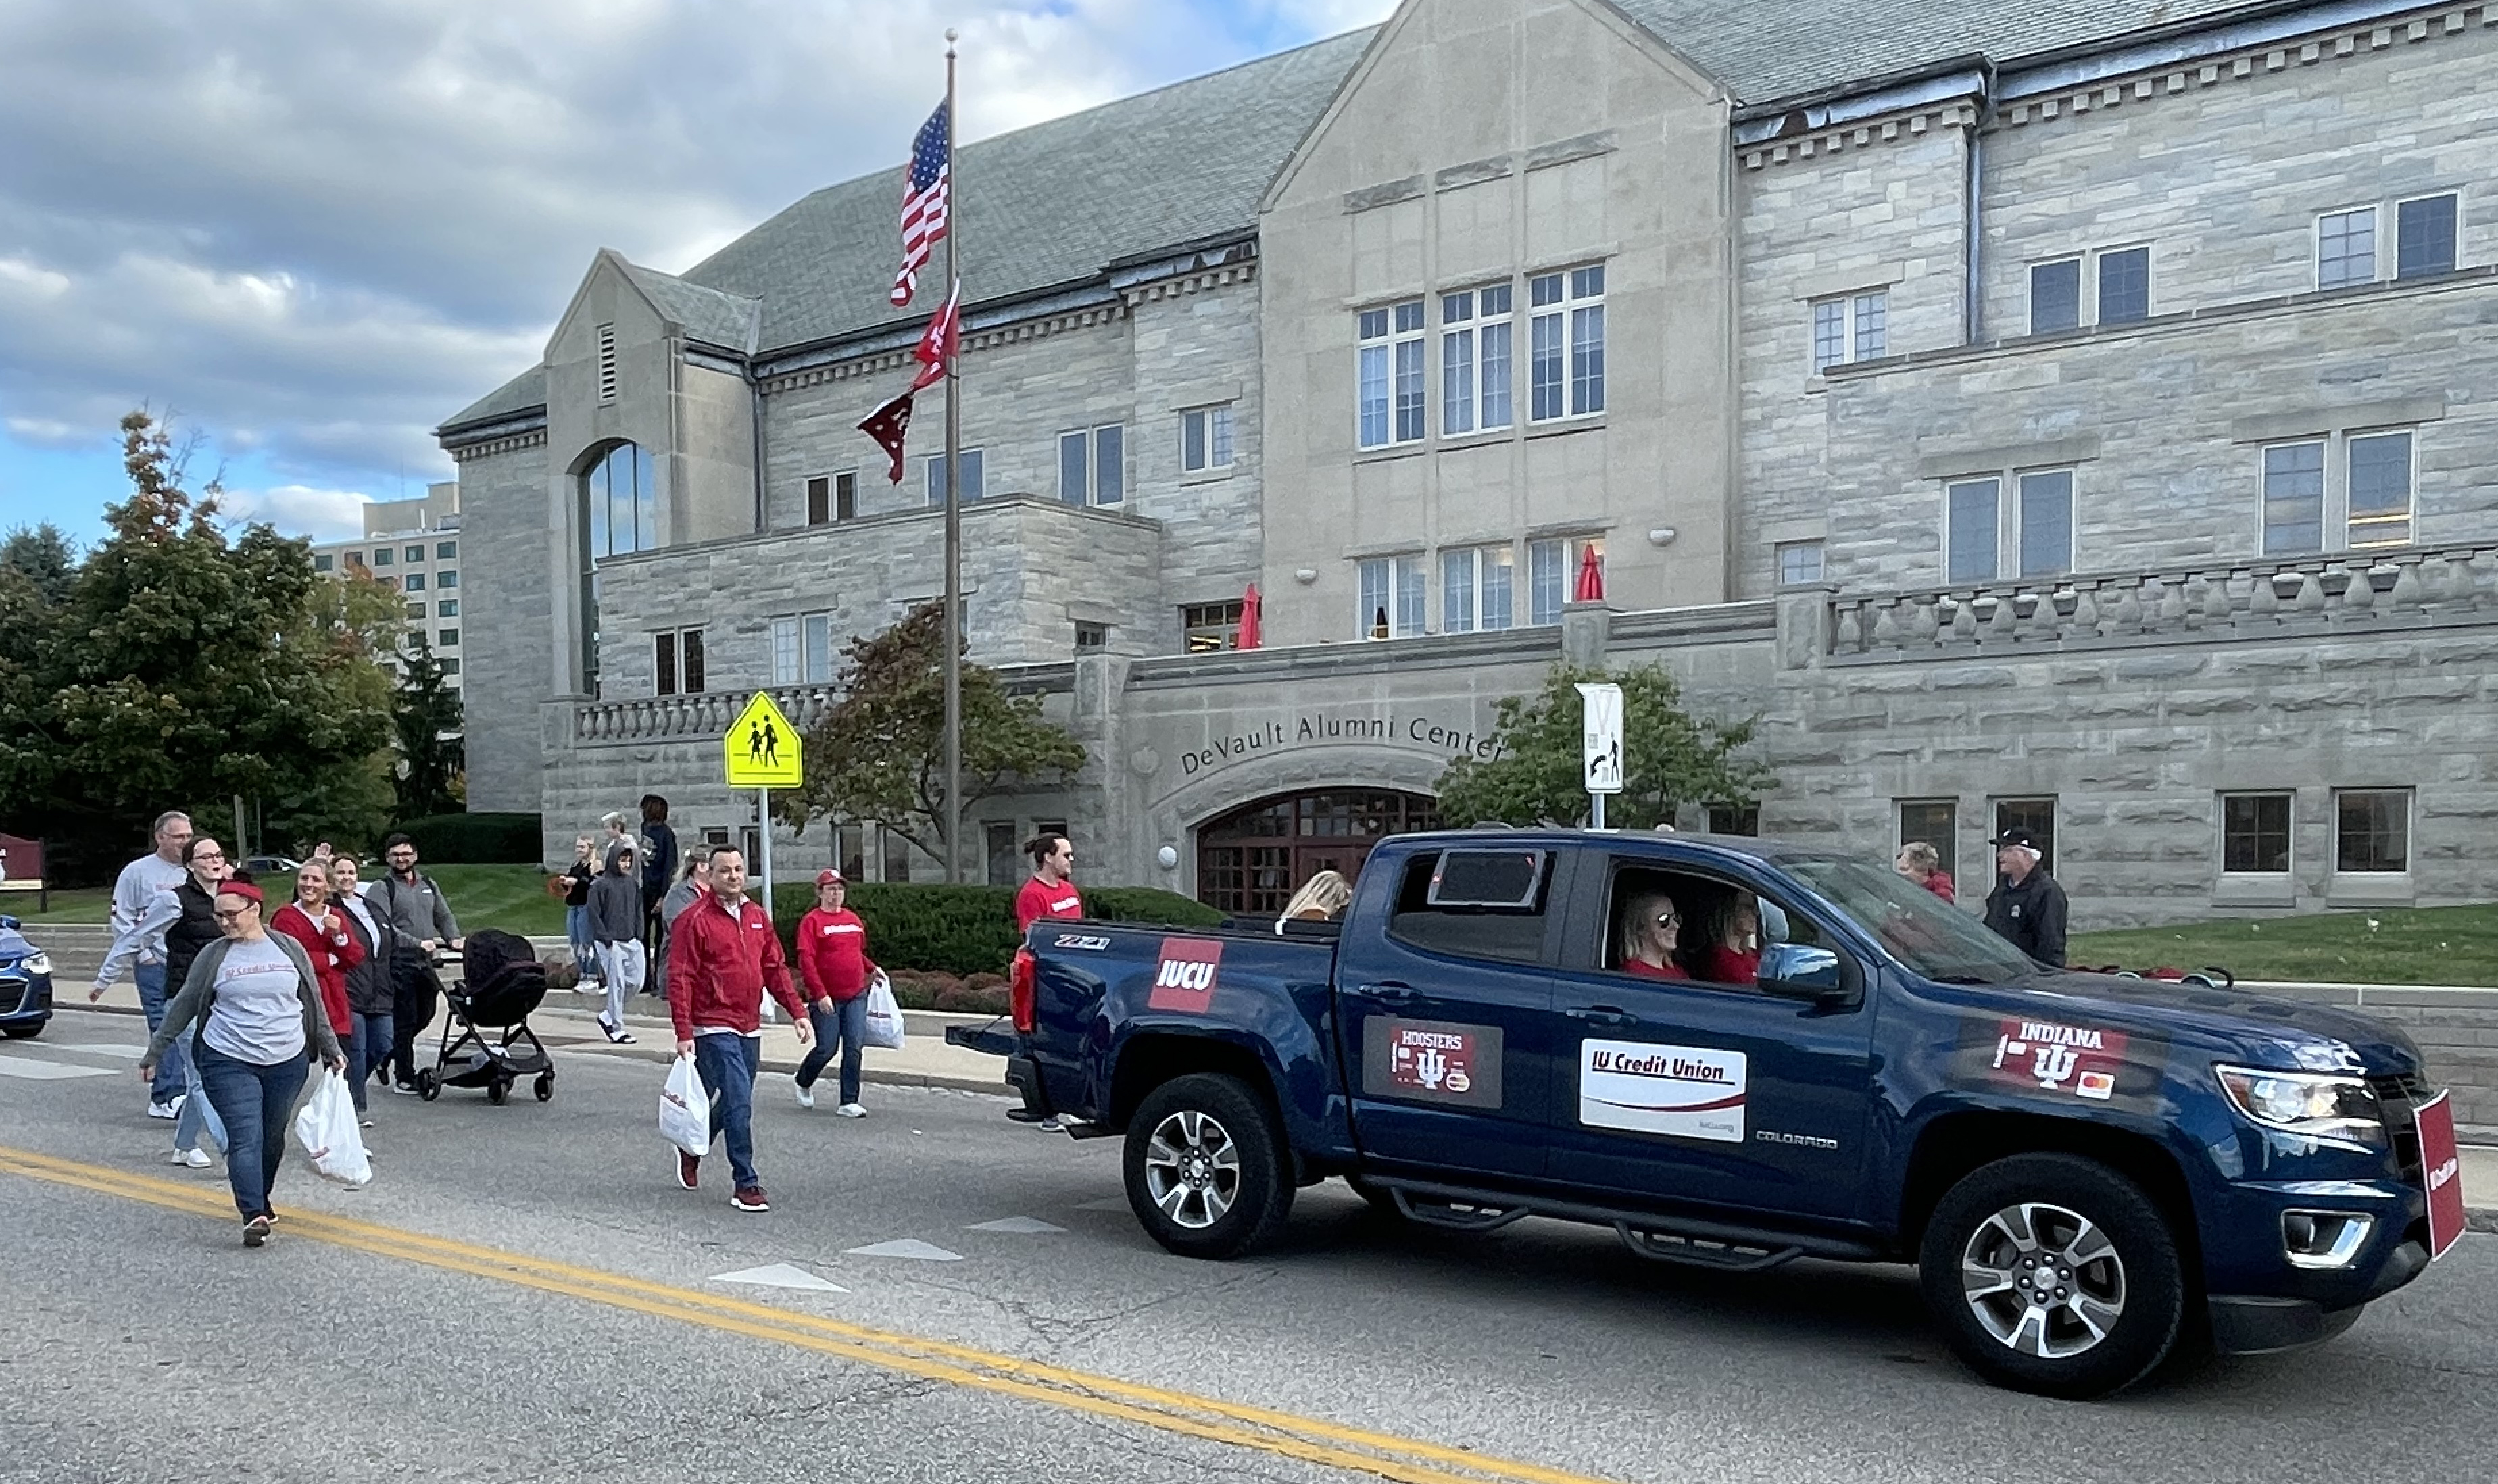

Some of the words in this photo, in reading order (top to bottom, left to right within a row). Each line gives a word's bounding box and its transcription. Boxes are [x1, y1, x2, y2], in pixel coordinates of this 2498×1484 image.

[1181, 722, 1284, 774] DeVault
[1297, 714, 1395, 741] Alumni
[1409, 717, 1507, 762] Center
[1156, 960, 1215, 991] IUCU
[1402, 1030, 1463, 1051] HOOSIERS
[2019, 1022, 2104, 1050] INDIANA
[1592, 1050, 1611, 1068] IU
[1614, 1052, 1667, 1074] Credit
[1672, 1058, 1725, 1080] Union
[1756, 1130, 1838, 1150] COLORADO
